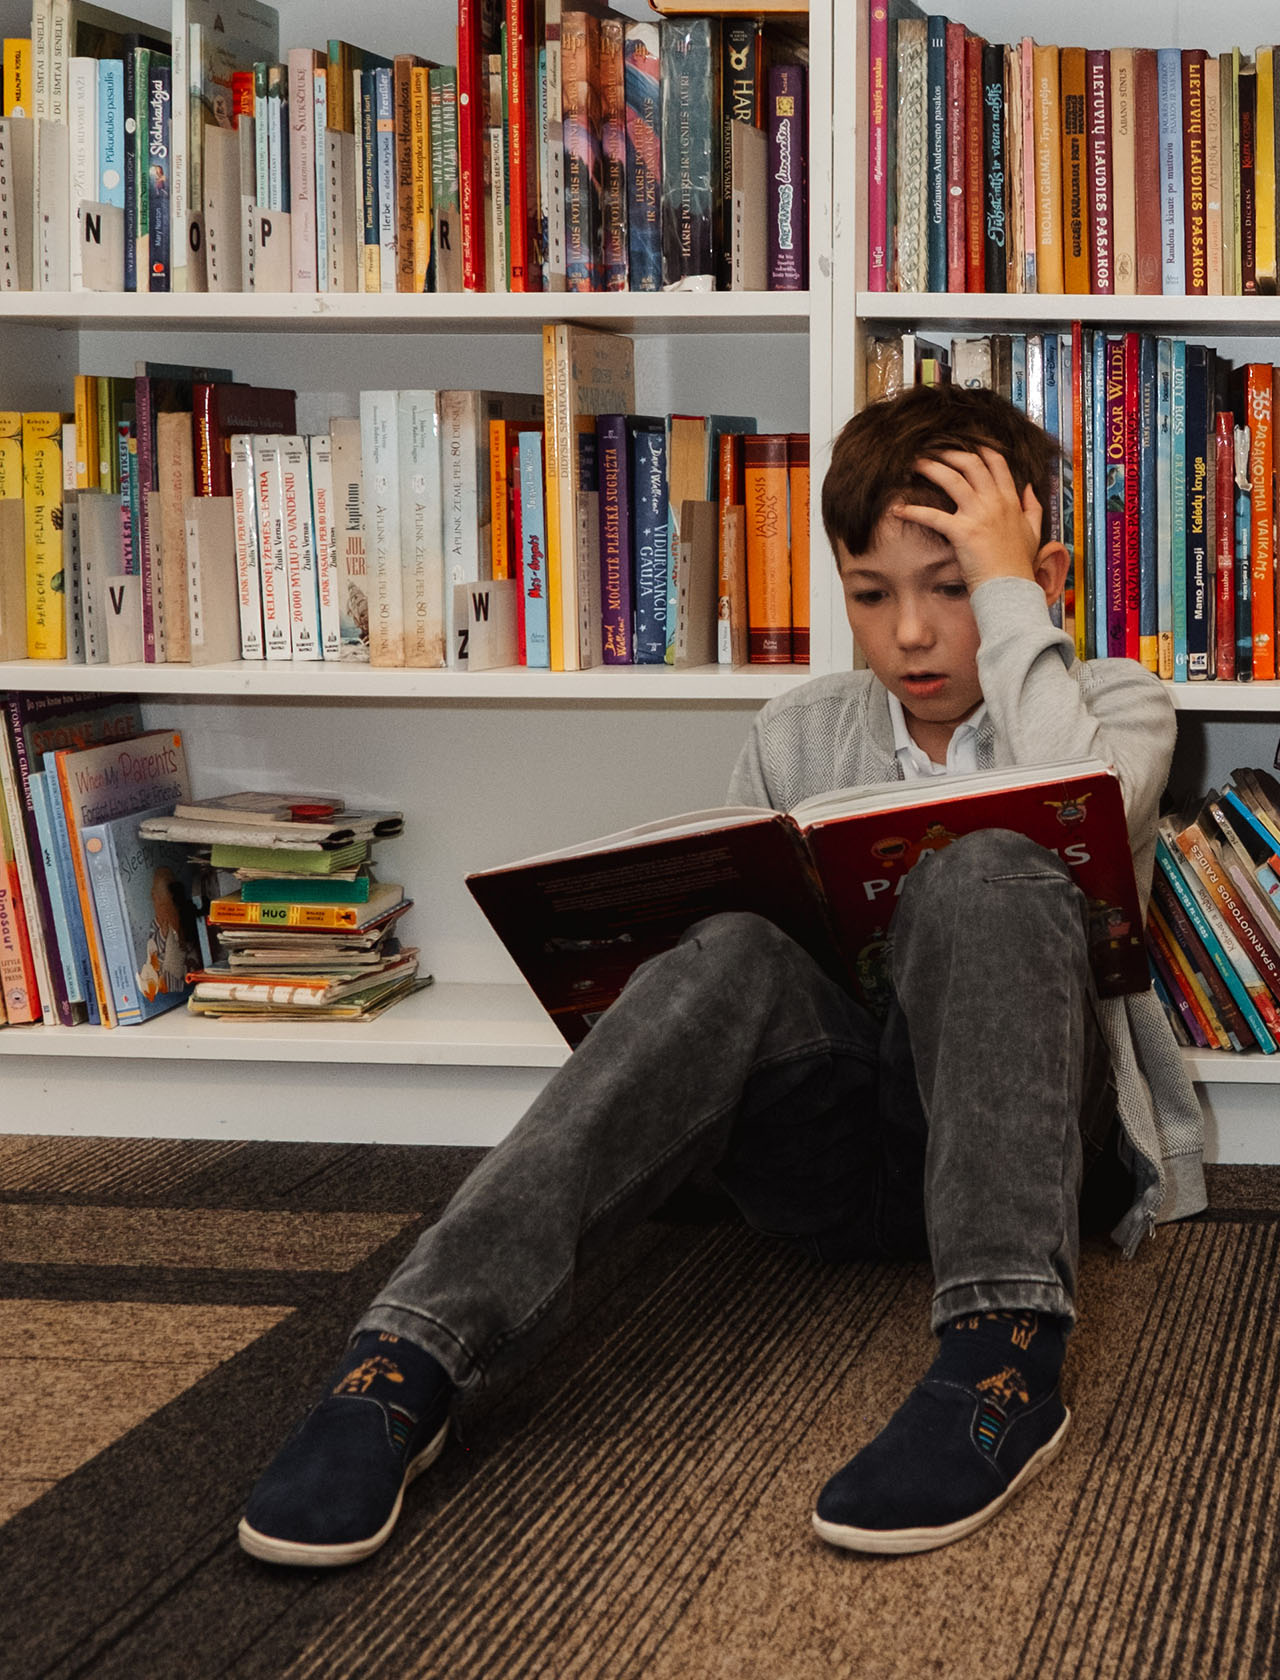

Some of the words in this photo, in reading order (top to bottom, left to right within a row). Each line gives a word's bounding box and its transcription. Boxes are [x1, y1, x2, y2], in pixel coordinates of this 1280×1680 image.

[35, 60, 45, 94] ŠIMTAI
[52, 61, 62, 95] ŠIMTAI
[103, 71, 116, 110] pasaulis
[36, 99, 45, 113] DU
[442, 82, 456, 132] VANDENIS
[932, 85, 944, 121] pasakos
[1091, 64, 1105, 135] LIETUVIŲ
[1188, 64, 1201, 133] LIETUVIŲ
[104, 111, 115, 163] Pūkuotuko
[932, 123, 942, 172] Anderseno
[991, 123, 1001, 156] viena
[680, 157, 690, 169] IR
[991, 160, 1001, 170] ir
[1040, 148, 1052, 195] GRIMAI
[1095, 140, 1107, 212] LIAUDIES
[1190, 139, 1203, 211] LIAUDIES
[635, 169, 645, 203] HARIS
[681, 172, 691, 220] POTERIS
[932, 173, 944, 224] Gražiausios
[1167, 182, 1177, 194] po
[85, 212, 101, 244] N
[261, 218, 272, 247] P
[645, 211, 656, 222] IR
[1041, 198, 1053, 245] BROLIAI
[155, 230, 163, 246] Mary
[189, 221, 200, 253] O
[439, 220, 451, 251] R
[681, 223, 691, 257] HARIS
[1096, 217, 1109, 289] PASAKOS
[1192, 216, 1204, 288] PASAKOS
[1107, 346, 1125, 401] WILDE
[1174, 365, 1184, 402] TONY
[544, 359, 555, 433] SMARAGDAS
[557, 359, 568, 433] SMARAGDAS
[1252, 387, 1270, 421] 365
[1108, 406, 1125, 459] OSCAR
[1174, 405, 1184, 436] ROSS
[450, 441, 461, 457] 80
[546, 436, 556, 478] DIDYSIS
[559, 437, 569, 478] DIDYSIS
[452, 460, 462, 480] PER
[1192, 457, 1206, 491] knyga
[1251, 424, 1269, 512] PASAKOJIMAI
[236, 514, 245, 525] 80
[284, 472, 297, 532] VANDENIU
[754, 477, 769, 539] JAUNASIS
[766, 495, 779, 537] VADAS
[1192, 495, 1205, 534] Kalėdų
[237, 526, 246, 542] PER
[273, 519, 282, 546] Vernas
[301, 522, 310, 548] Vernas
[414, 503, 426, 543] APLINK
[451, 517, 463, 556] APLINK
[288, 534, 298, 550] PO
[1111, 520, 1122, 565] VAIKAMS
[1254, 519, 1268, 580] VAIKAMS
[290, 552, 301, 588] MYLIŲ
[639, 546, 654, 597] GAUJA
[1194, 547, 1205, 587] pirmoji
[109, 585, 125, 615] V
[239, 578, 250, 606] APLINK
[1112, 566, 1122, 612] PASAKOS
[1221, 570, 1229, 601] Siaubo
[416, 601, 427, 617] 80
[472, 591, 489, 622] W
[1194, 588, 1203, 620] Mano
[9, 702, 22, 733] STONE
[15, 735, 25, 754] AGE
[18, 756, 34, 812] CHALLENGE
[118, 746, 178, 786] Parents
[262, 909, 287, 919] HUG
[1214, 883, 1278, 972] SPARNUOTOSIOS
